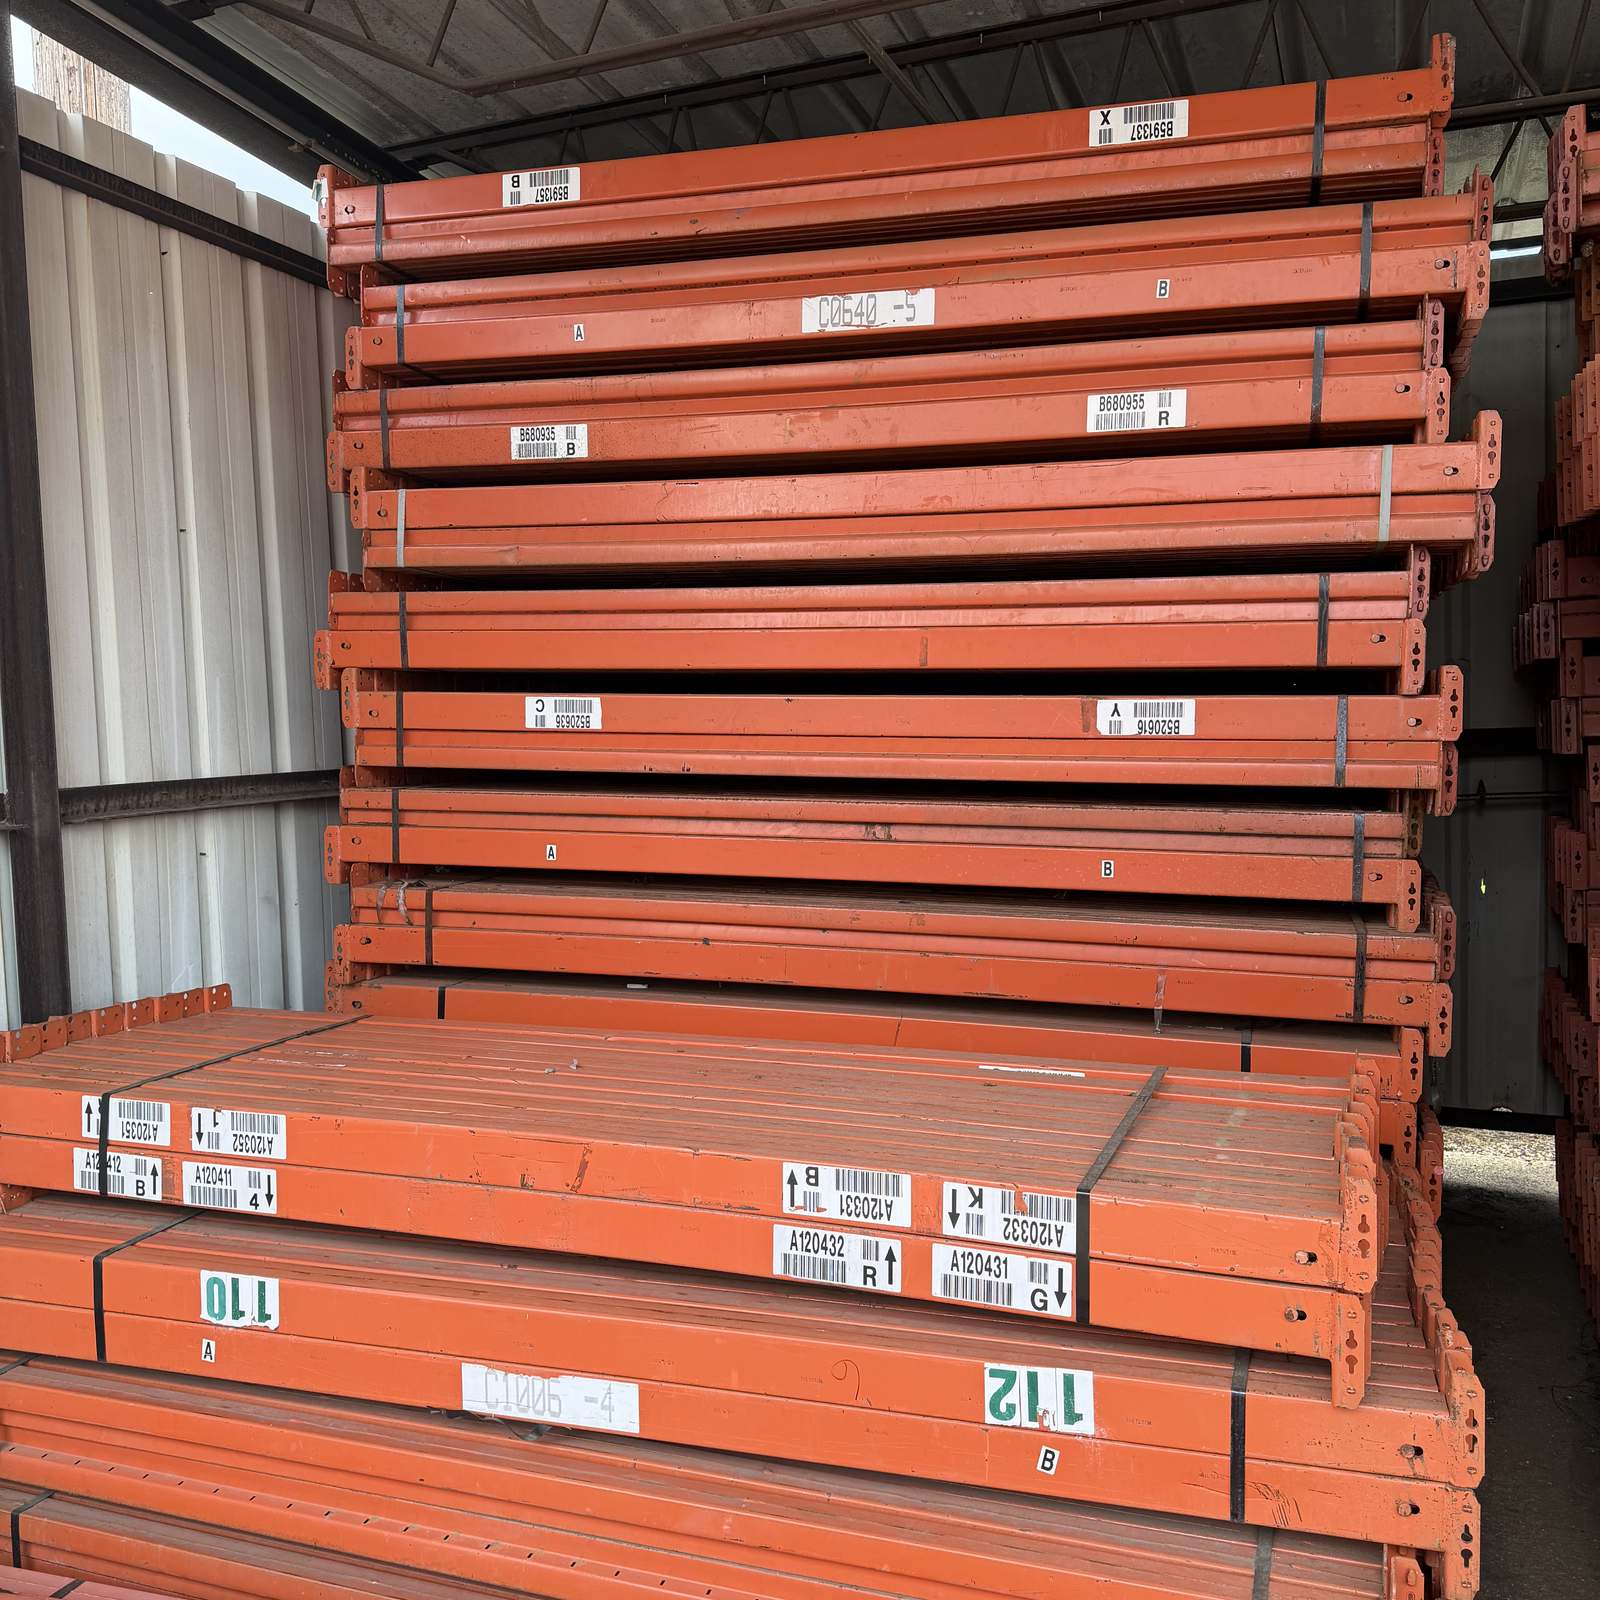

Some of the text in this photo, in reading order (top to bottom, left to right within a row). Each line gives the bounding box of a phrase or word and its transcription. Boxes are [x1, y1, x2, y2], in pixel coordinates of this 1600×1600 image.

[1100, 110, 1111, 126] X
[1130, 121, 1173, 141] B591337
[511, 175, 520, 188] B
[535, 186, 568, 202] B591357
[1158, 280, 1168, 297] B
[819, 294, 877, 328] C0640
[575, 325, 584, 340] A
[1099, 394, 1145, 412] B680955
[1158, 411, 1169, 426] R
[520, 427, 556, 442] B680935
[566, 442, 576, 456] B
[535, 699, 545, 713] C
[1110, 703, 1121, 717] Y
[556, 714, 591, 728] B520636
[1137, 719, 1180, 735] B520616
[548, 846, 555, 859] A
[1104, 861, 1113, 876] B
[121, 1121, 158, 1142] A120351
[232, 1133, 274, 1155] A120352
[85, 1152, 122, 1173] A12412
[195, 1165, 232, 1187] A120411
[805, 1166, 819, 1187] B
[136, 1180, 145, 1196] B
[968, 1186, 983, 1209] K
[249, 1193, 260, 1210] 4
[840, 1194, 893, 1221] A120331
[1003, 1217, 1064, 1248] A120332
[790, 1229, 845, 1257] A120432
[950, 1250, 1008, 1279] A120431
[863, 1265, 877, 1287] R
[206, 1276, 272, 1323] 110
[1030, 1288, 1048, 1312] G
[203, 1341, 213, 1360] A
[989, 1368, 1083, 1426] 112
[1041, 1449, 1055, 1472] B
